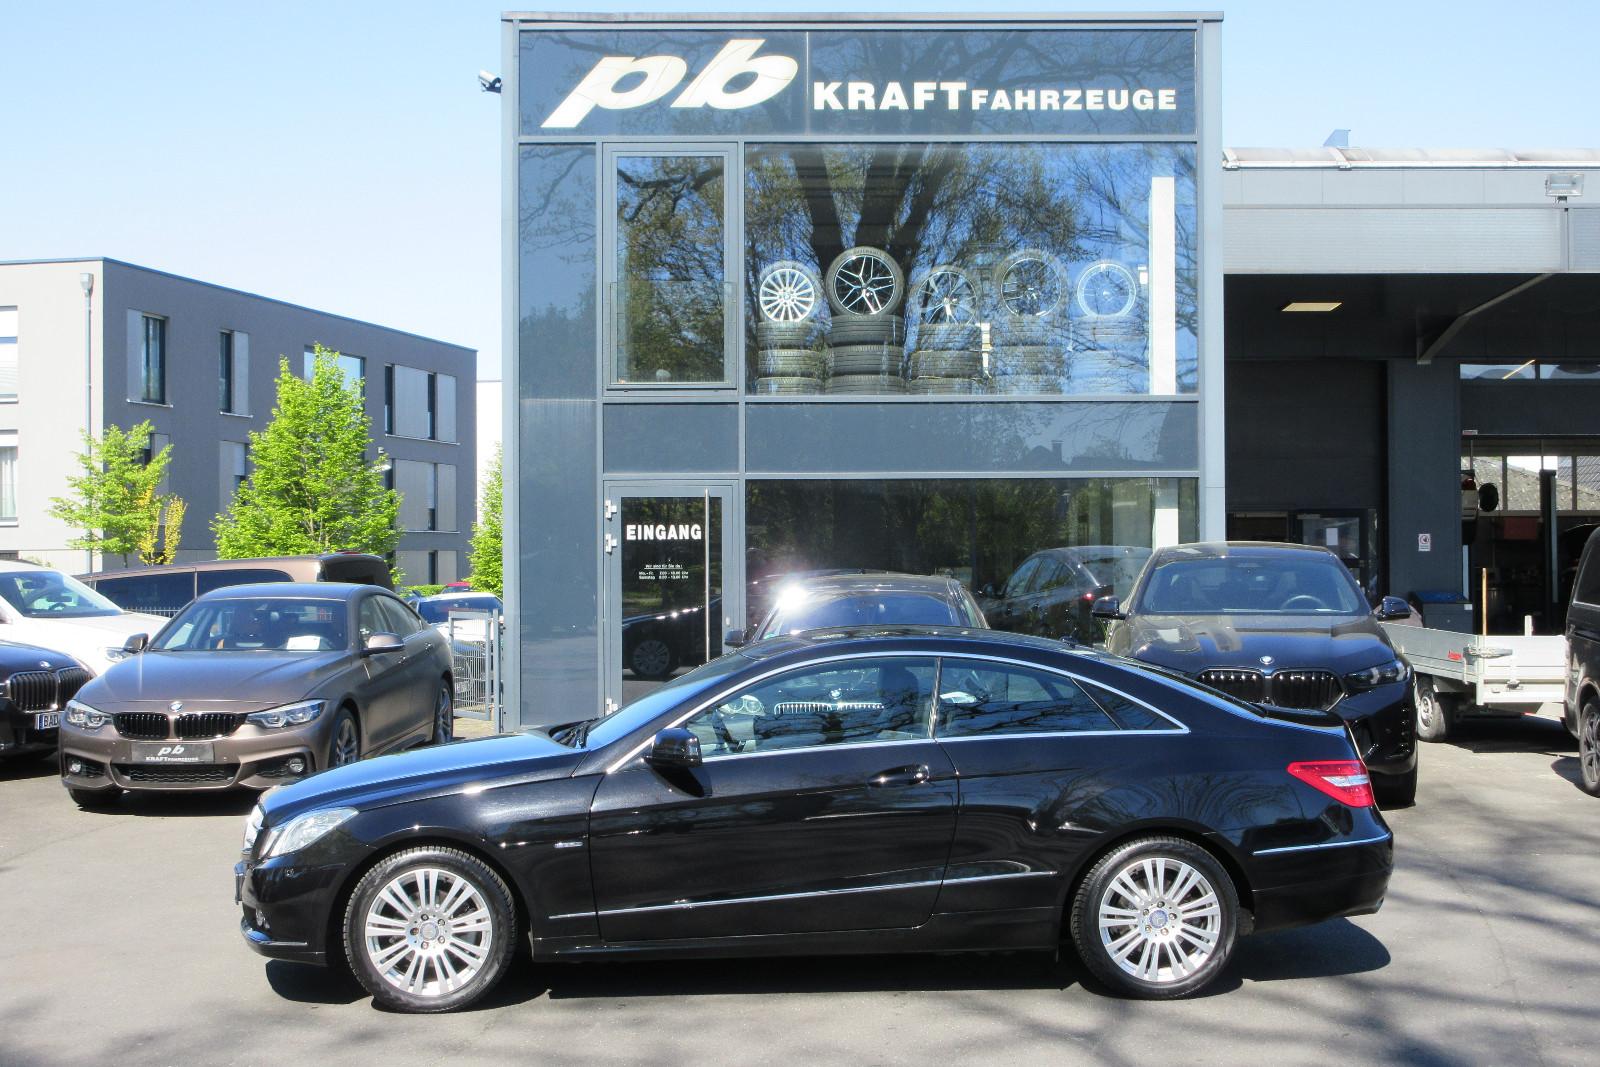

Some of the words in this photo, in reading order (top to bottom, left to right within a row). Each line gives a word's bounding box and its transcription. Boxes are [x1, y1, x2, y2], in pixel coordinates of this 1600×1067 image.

[540, 38, 798, 128] pb
[626, 523, 702, 541] EINGANG
[157, 744, 185, 756] pb
